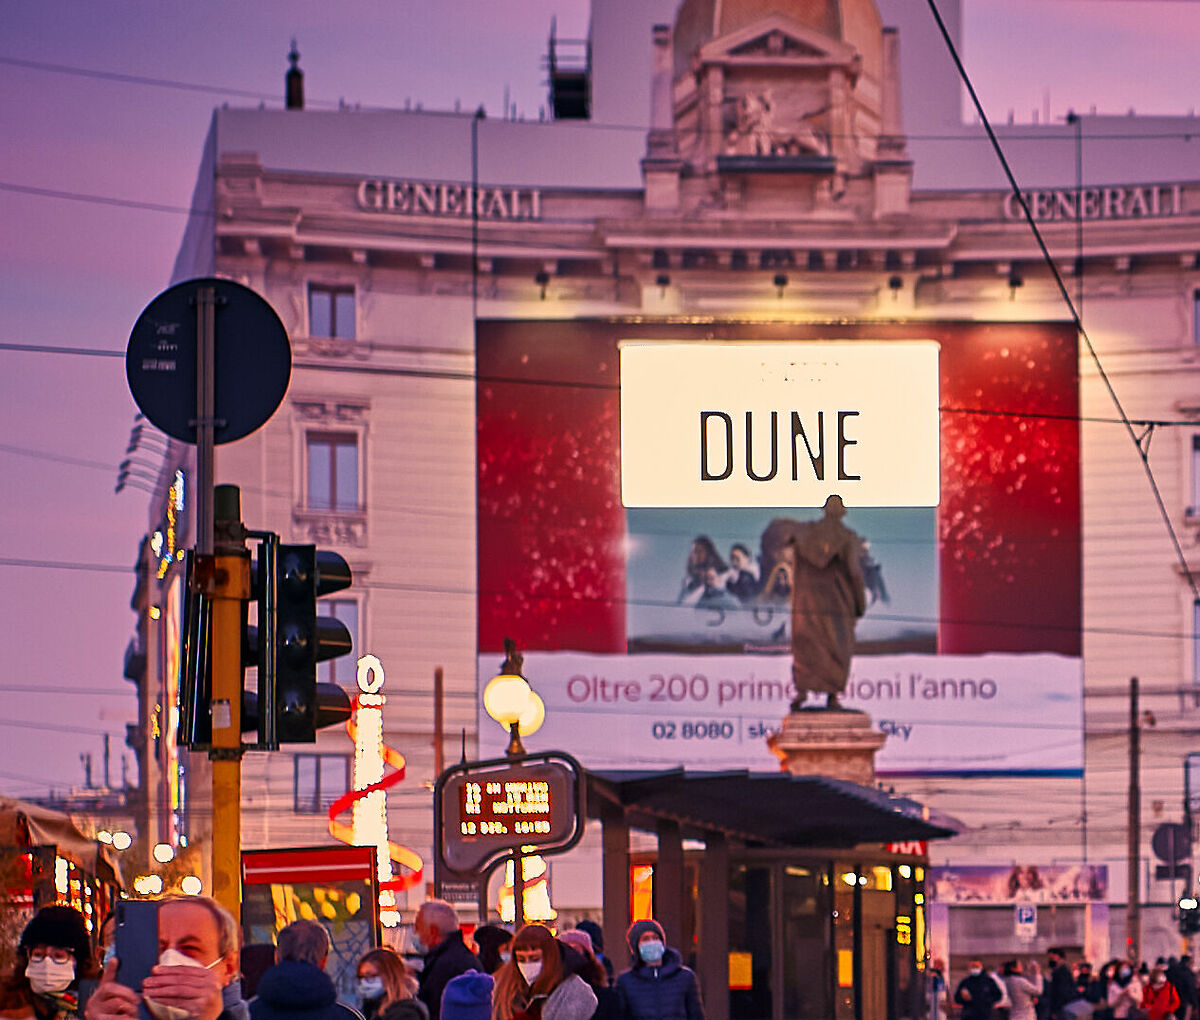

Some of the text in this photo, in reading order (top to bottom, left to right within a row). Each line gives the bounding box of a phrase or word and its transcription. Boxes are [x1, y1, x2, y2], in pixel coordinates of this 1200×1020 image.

[358, 179, 542, 219] GENERALI
[1004, 183, 1183, 221] GENERALI
[700, 411, 861, 482] DUNE
[567, 674, 641, 703] Oltre
[650, 674, 709, 702] 200
[652, 721, 676, 740] 02
[682, 720, 734, 740] 8080
